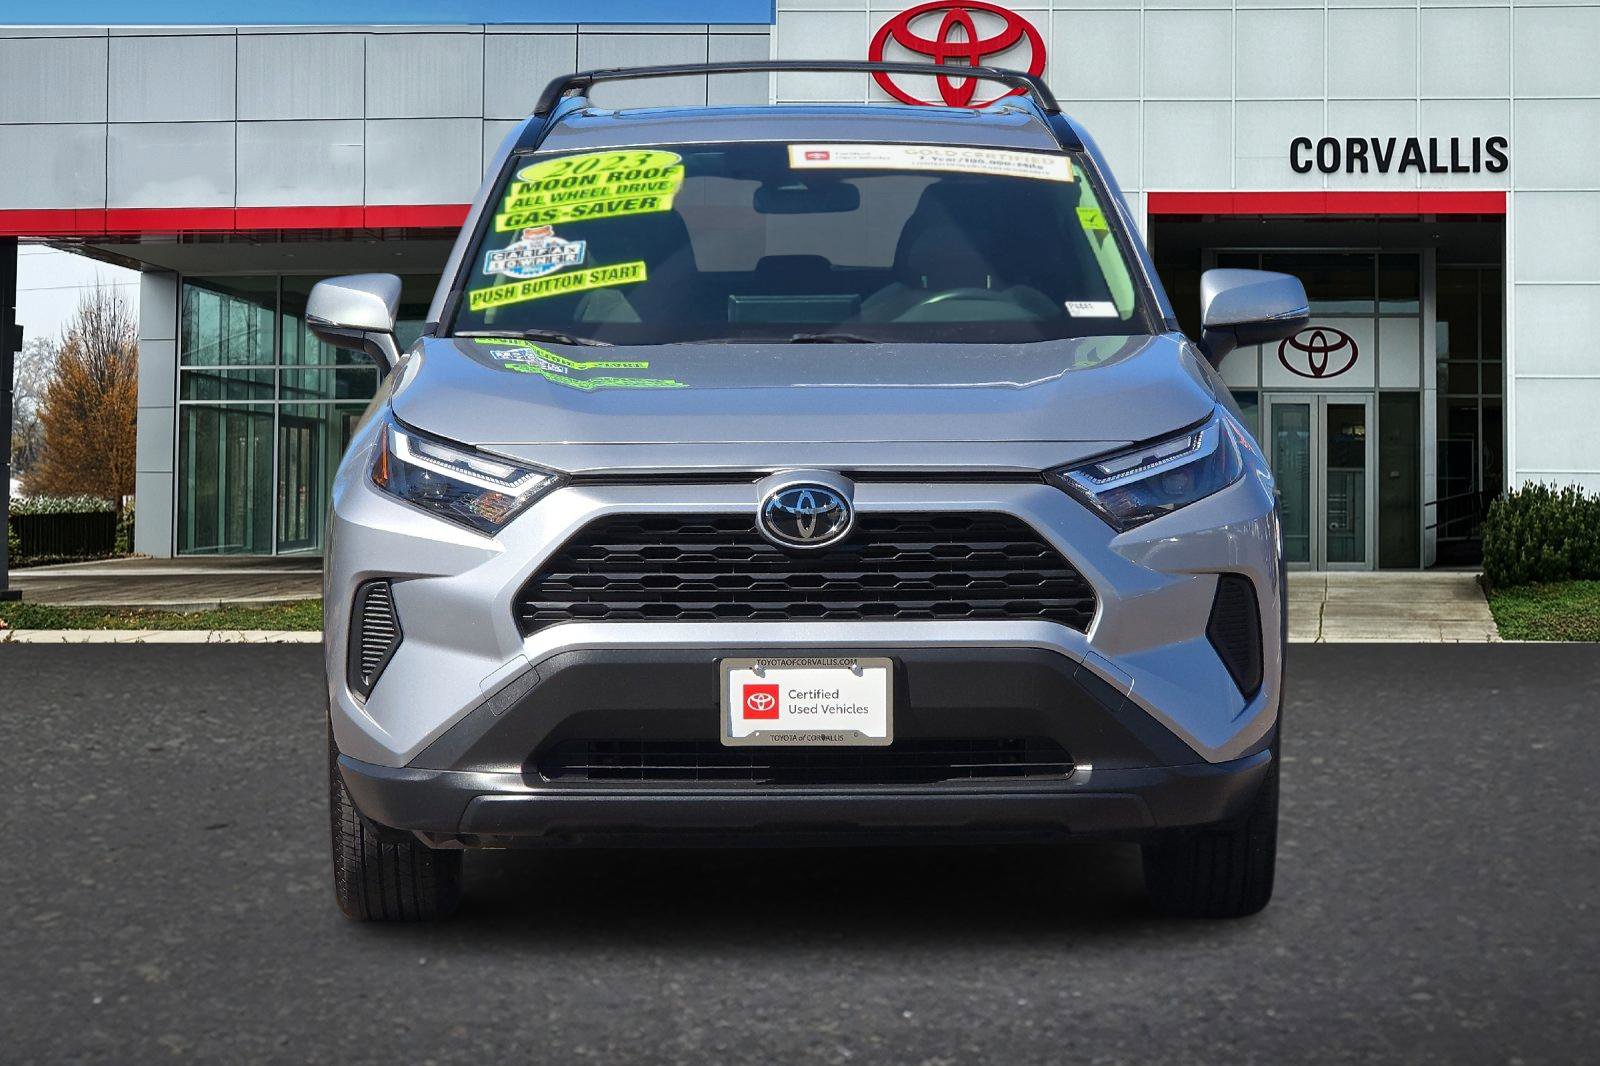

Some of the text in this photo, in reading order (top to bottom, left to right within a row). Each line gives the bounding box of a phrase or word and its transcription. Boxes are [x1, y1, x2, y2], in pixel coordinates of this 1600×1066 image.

[545, 153, 652, 180] 2023
[1290, 136, 1508, 174] CORVALLIS
[517, 166, 677, 194] MOON ROOF
[510, 180, 669, 208] ALL WHEEL DRIVE
[504, 196, 658, 228] GAS-SAVER
[471, 265, 641, 306] PUSH BUTTON START
[756, 658, 858, 667] TOYOTAOFCORVALLIS.COM
[788, 689, 840, 700] Certified
[788, 703, 869, 714] Used Vehicles
[770, 734, 798, 742] TOYOTA
[798, 734, 807, 742] of
